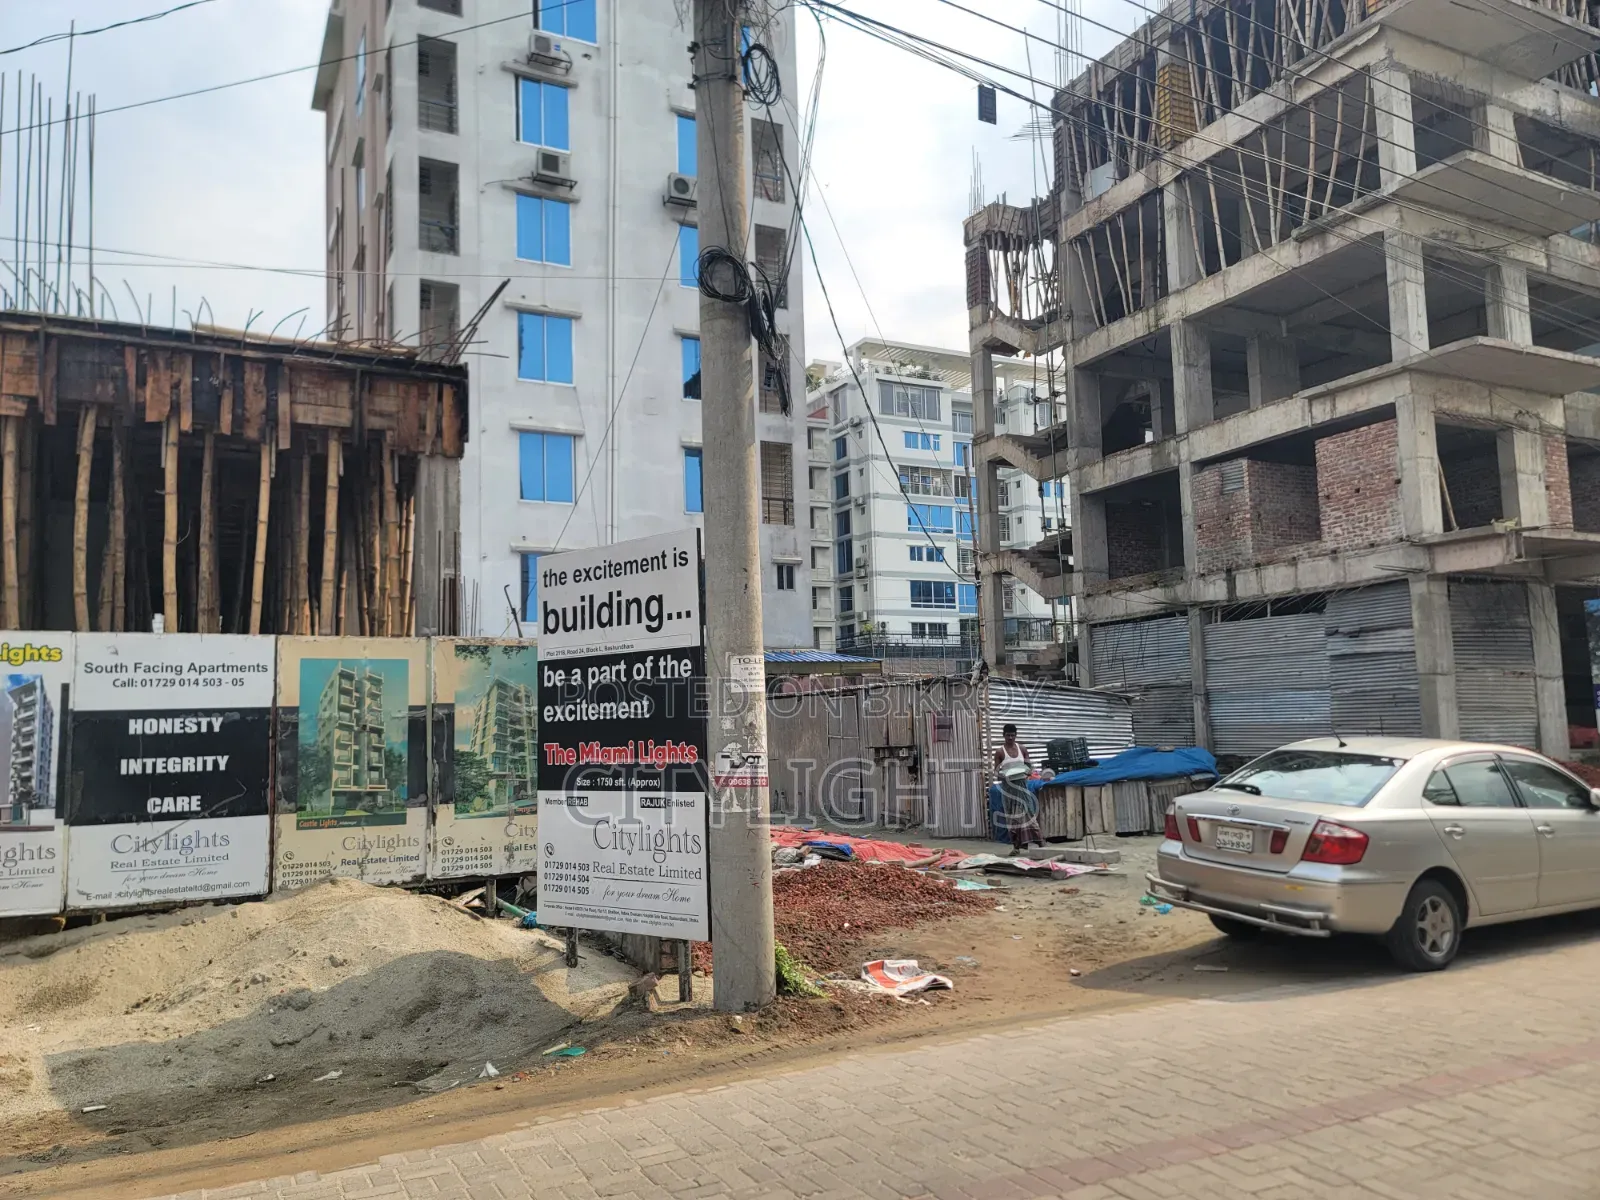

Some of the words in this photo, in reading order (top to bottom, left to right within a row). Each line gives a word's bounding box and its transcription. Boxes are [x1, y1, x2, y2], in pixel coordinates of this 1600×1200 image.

[543, 569, 567, 588] the
[573, 550, 667, 583] excitement
[673, 547, 689, 568] is
[543, 590, 691, 635] building...
[0, 642, 62, 666] ights
[84, 662, 128, 674] South
[133, 662, 183, 676] Facing
[187, 662, 268, 675] Apartments
[543, 665, 565, 688] be
[571, 668, 581, 686] a
[588, 659, 627, 691] part
[633, 656, 654, 681] of
[658, 654, 692, 679] the
[112, 678, 138, 688] Call:
[140, 678, 176, 688] 01729
[179, 678, 200, 687] 014
[202, 678, 222, 687] 503
[231, 677, 245, 687] 05
[543, 695, 650, 723] excitement
[128, 716, 223, 735] HONESTY
[544, 742, 576, 766] The
[579, 740, 635, 765] Miami
[638, 739, 698, 770] Lights
[120, 755, 229, 775] INTEGRITY
[576, 778, 591, 787] Size
[597, 778, 613, 787] 1750
[628, 777, 661, 789] (Approx)
[146, 795, 202, 814] CARE
[568, 797, 588, 806] REHAB
[640, 798, 666, 808] RAJUK
[667, 798, 695, 808] Enlisted
[299, 820, 317, 828] Castle
[110, 830, 230, 856] Citylights
[342, 834, 420, 853] Citylights
[503, 844, 522, 853] Real
[593, 820, 702, 863] Citylights
[110, 859, 137, 869] Real
[142, 857, 181, 867] Estate
[185, 853, 229, 864] Limited
[341, 858, 359, 866] Real
[362, 856, 387, 865] Estate
[389, 854, 420, 863] Limited
[544, 862, 563, 870] 01729
[564, 862, 576, 870] 014
[578, 863, 590, 871] 503
[9, 866, 55, 876] Limited
[160, 871, 186, 879] dream
[187, 867, 219, 876] Home
[544, 873, 563, 881] 01729
[564, 874, 576, 882] 014
[578, 874, 590, 883] 504
[592, 861, 615, 874] Real
[619, 863, 655, 877] Estate
[658, 865, 702, 880] Limited
[86, 892, 112, 900] E-mail
[544, 885, 563, 893] 01729
[564, 886, 576, 894] 014
[578, 886, 590, 895] 505
[616, 888, 635, 902] your
[637, 888, 661, 900] dream
[661, 887, 692, 903] Home
